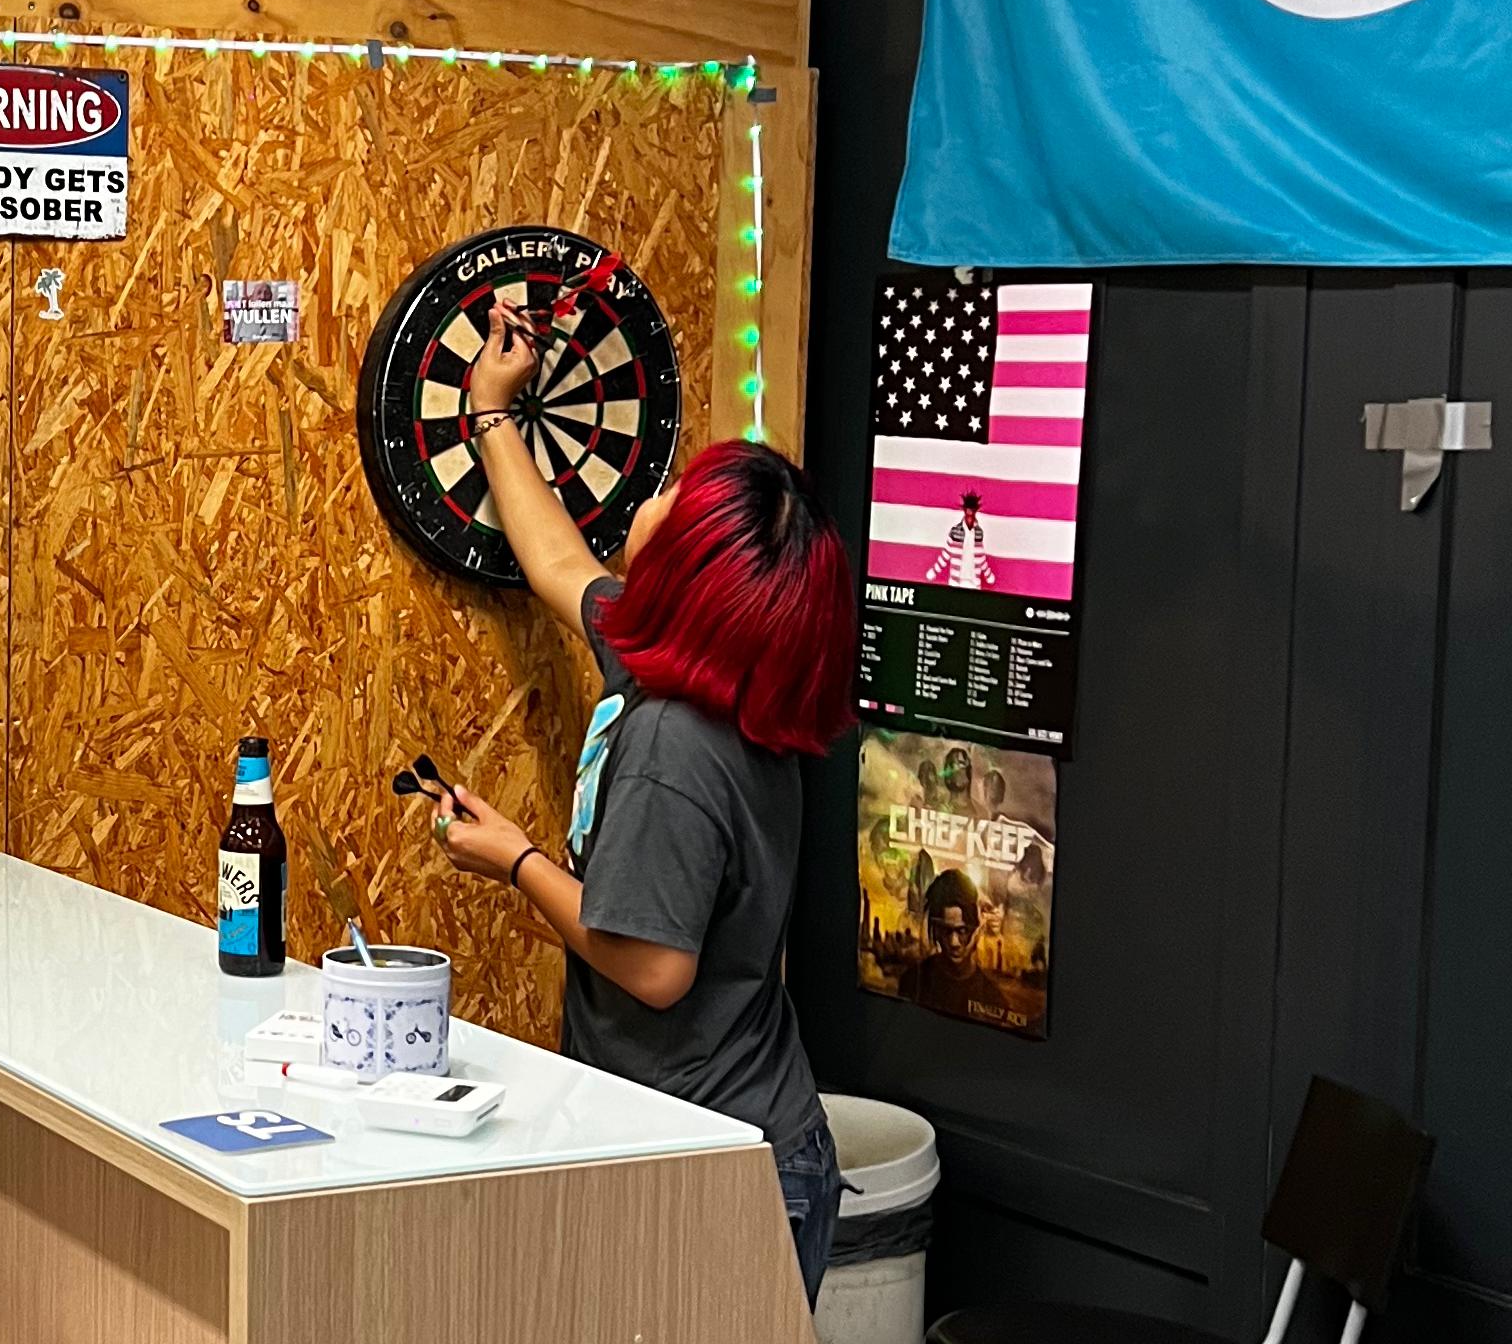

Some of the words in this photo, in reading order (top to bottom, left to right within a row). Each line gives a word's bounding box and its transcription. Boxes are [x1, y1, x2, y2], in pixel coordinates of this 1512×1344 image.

[45, 168, 125, 193] GETS
[0, 197, 103, 222] SOBER
[231, 309, 292, 324] VULLEN
[865, 583, 889, 602] PINK
[890, 586, 915, 605] TAPE
[889, 804, 969, 849] CHIEF
[966, 816, 1035, 863] KEEF
